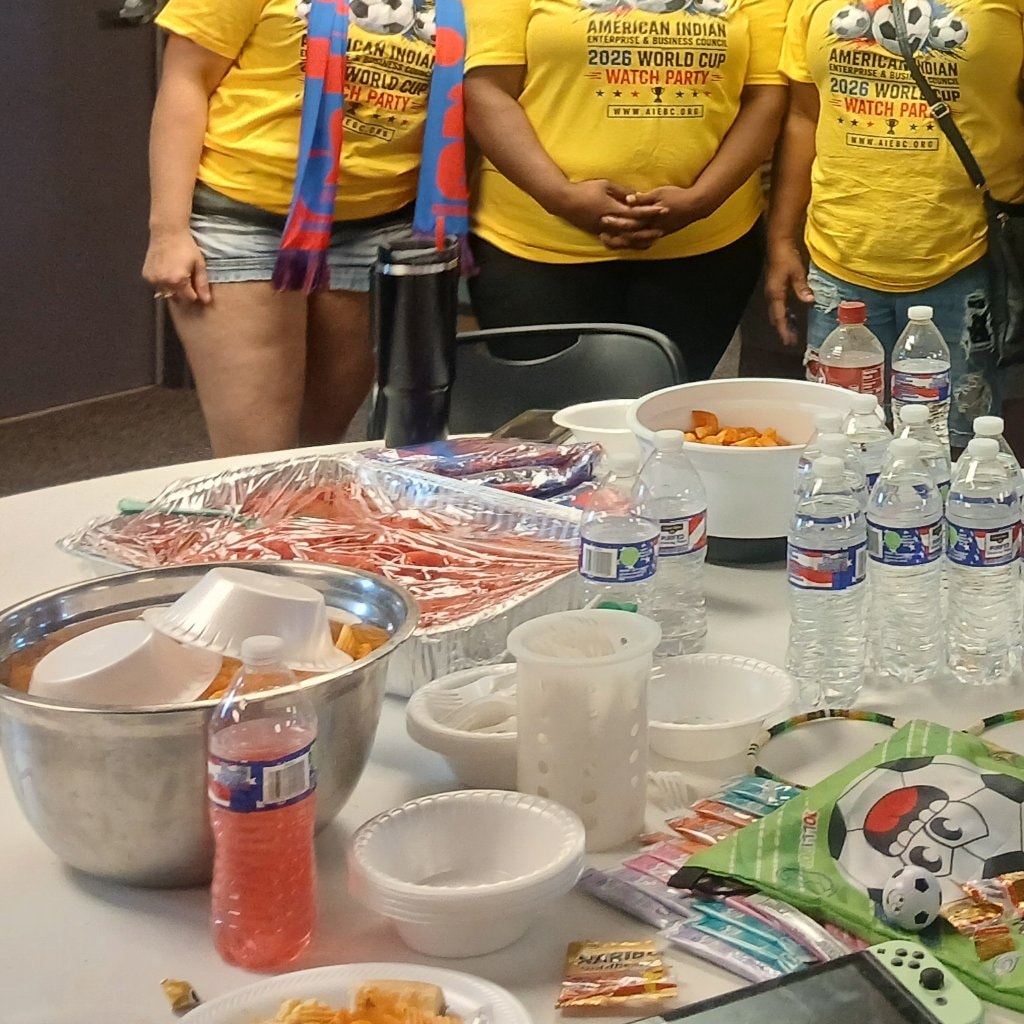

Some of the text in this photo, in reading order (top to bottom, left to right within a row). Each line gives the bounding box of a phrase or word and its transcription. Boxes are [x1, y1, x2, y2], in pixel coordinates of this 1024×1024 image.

[587, 20, 726, 38] AMERICAN INDIAN
[587, 36, 728, 48] ENTERPRISE & BUSINESS COUNCIL
[390, 45, 436, 69] INDIA
[588, 50, 726, 68] 2026 WORLD CUP
[829, 48, 958, 76] AMERICAN NDIAN
[346, 66, 398, 90] WORLD
[399, 79, 429, 96] CUP
[606, 68, 710, 86] WATCH PARTY
[829, 64, 878, 77] ENTERPRISE
[880, 70, 886, 78] &
[890, 72, 911, 80] BUSI
[830, 78, 869, 96] 2026
[366, 88, 410, 112] PARTY
[844, 97, 934, 118] WATCH PAR
